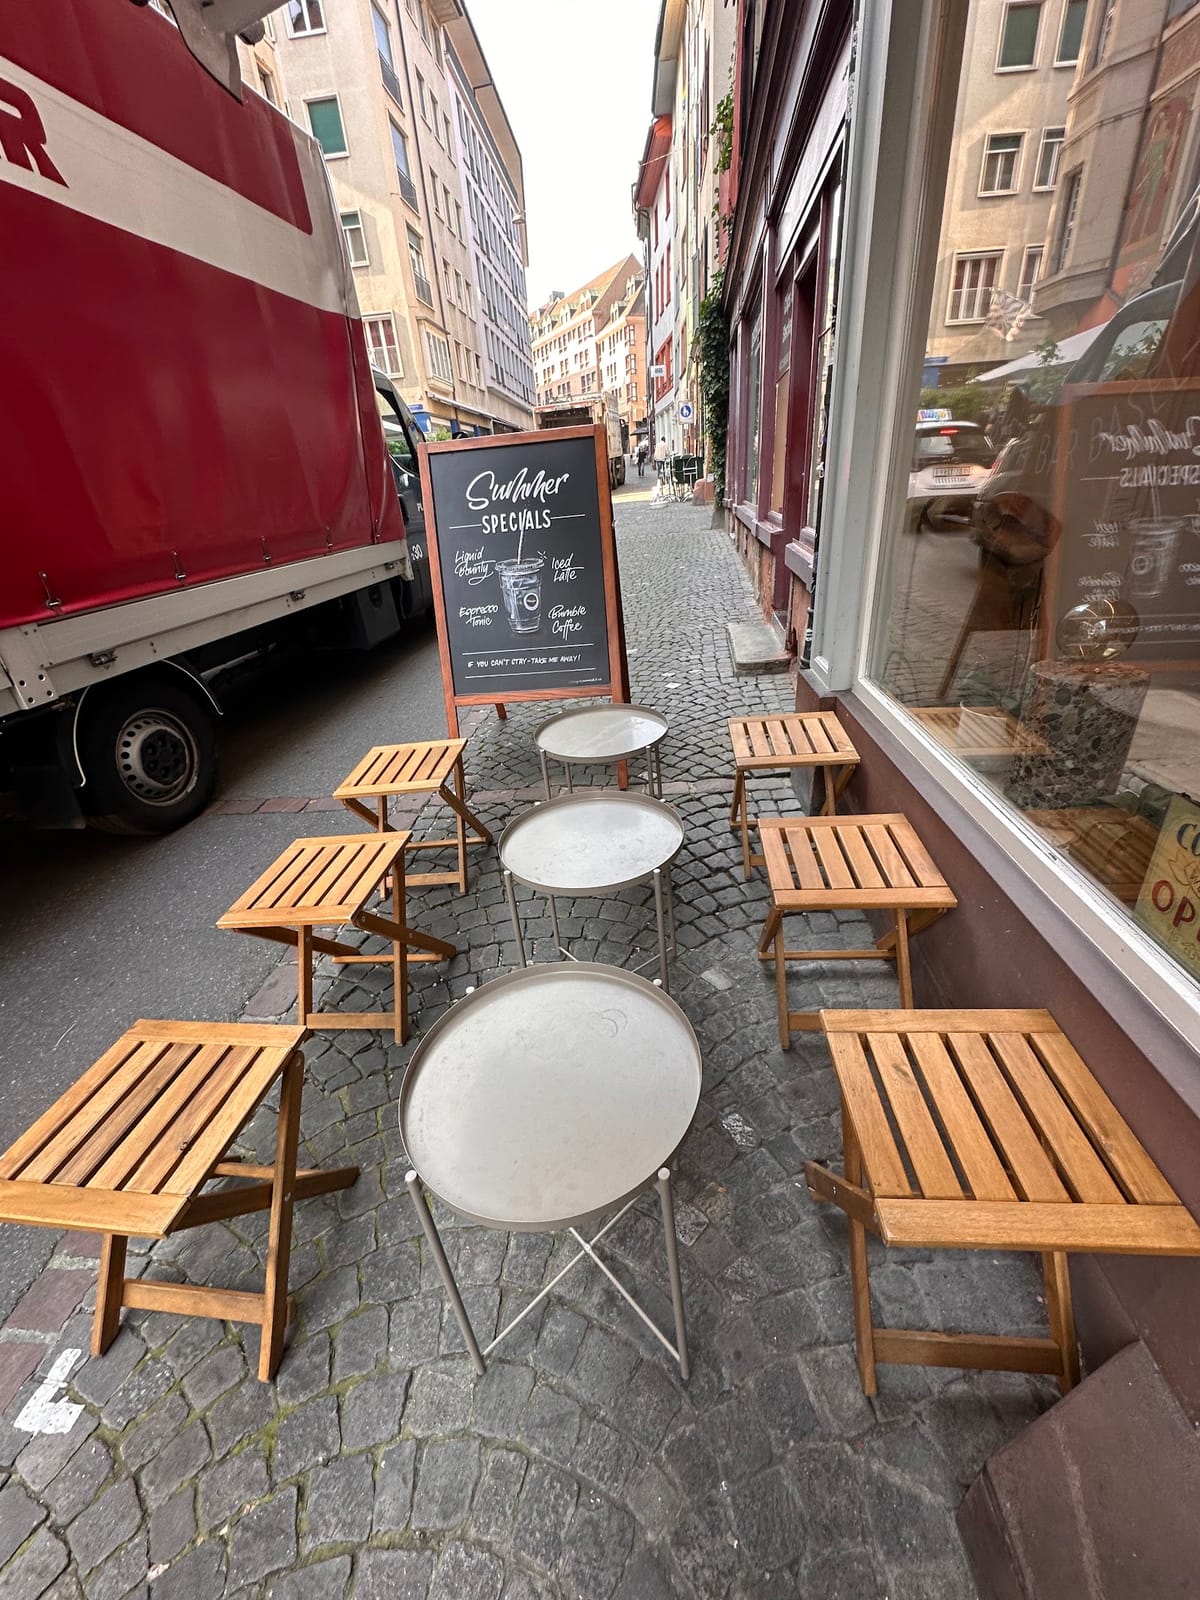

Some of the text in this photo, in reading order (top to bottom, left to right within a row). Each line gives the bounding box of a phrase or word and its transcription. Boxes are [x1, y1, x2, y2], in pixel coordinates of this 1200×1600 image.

[466, 467, 570, 510] Summer
[482, 509, 551, 534] SPECIALS
[454, 546, 485, 564] Liquid
[551, 553, 574, 570] Iced
[454, 560, 496, 585] Bounty
[553, 566, 584, 583] Latte
[459, 604, 499, 618] Espresso
[548, 604, 587, 620] Bumble
[466, 616, 492, 627] Tonic
[552, 619, 583, 640] Coffee
[476, 660, 489, 668] YOU
[490, 658, 510, 667] CAN'T
[560, 654, 581, 663] AWAY!
